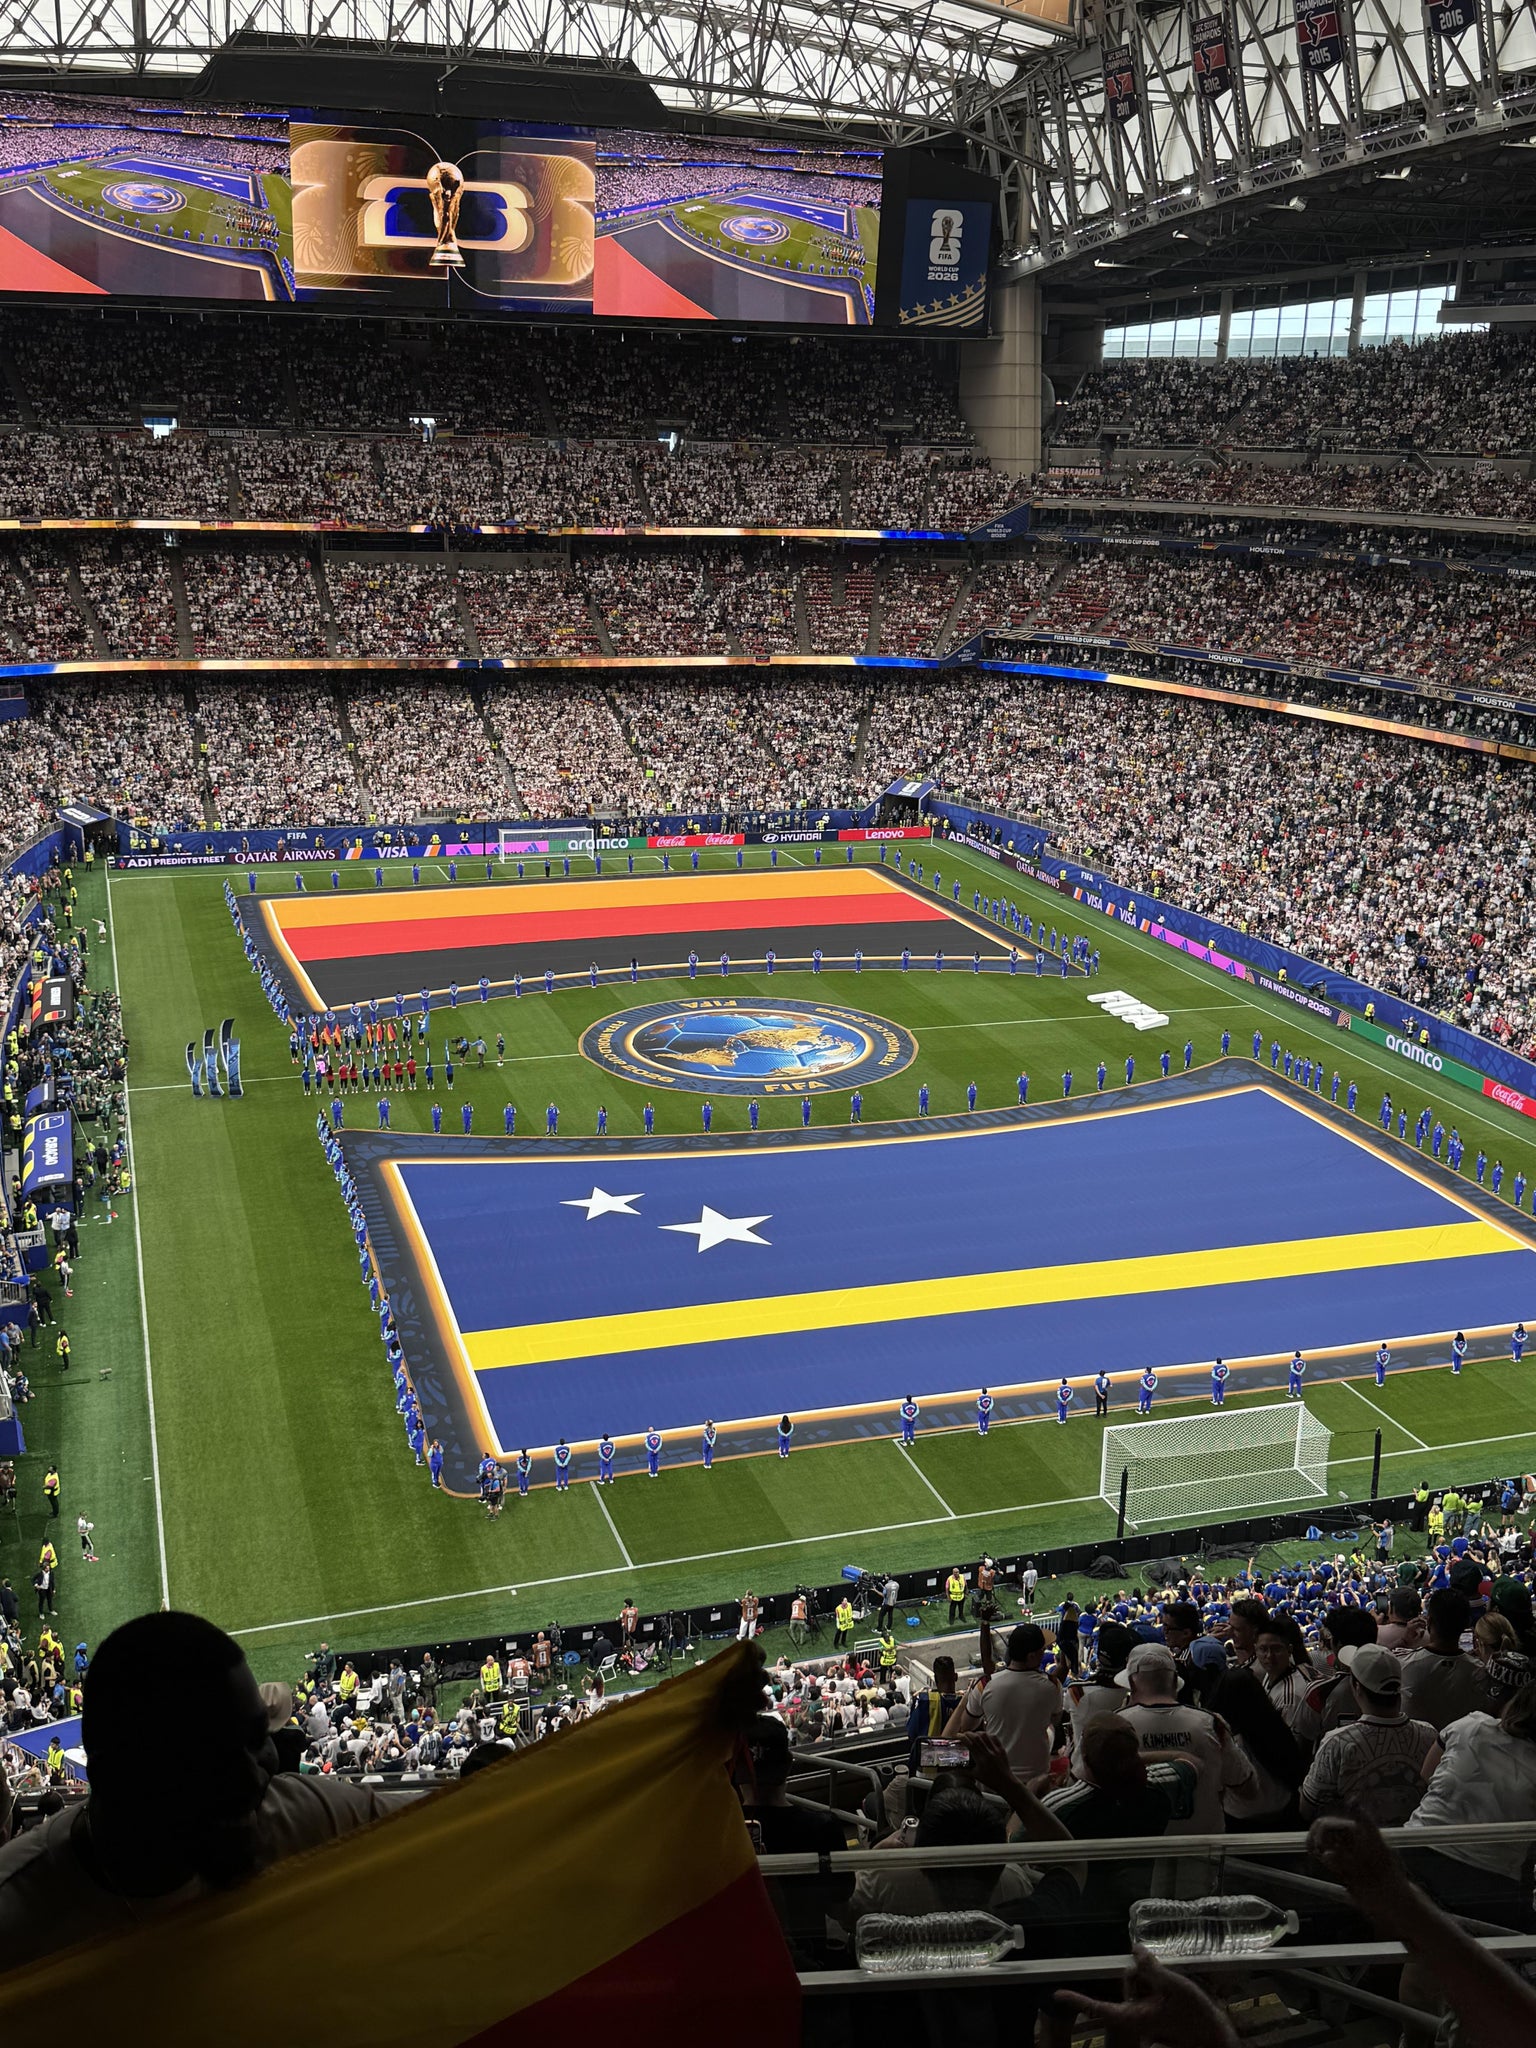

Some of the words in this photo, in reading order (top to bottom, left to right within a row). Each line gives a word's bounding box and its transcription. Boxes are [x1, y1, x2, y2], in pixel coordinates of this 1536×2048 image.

[1296, 0, 1332, 12] CHAMPIO
[1439, 9, 1464, 30] 2016
[1193, 26, 1221, 44] CHAMPIONS
[1309, 47, 1331, 65] 2015
[1203, 76, 1221, 93] 2012
[1117, 101, 1130, 117] 2011
[927, 272, 959, 281] 2026
[1249, 547, 1285, 555] HOUSTON
[1507, 567, 1519, 575] FIFA
[1208, 653, 1243, 664] HOUSTON
[1472, 695, 1516, 709] HOUSTON
[287, 832, 307, 840] FIFA
[780, 831, 822, 843] HYUNDAI
[865, 828, 905, 840] Lenovo
[568, 838, 629, 850] aramco
[948, 831, 965, 844] ADI
[966, 837, 1001, 860] PREDICTSTREET
[234, 852, 278, 864] QATAR
[283, 849, 336, 861] AIRWAYS
[376, 846, 409, 859] VISA
[127, 858, 151, 868] ADI
[154, 855, 226, 866] PREDICTSTREET
[1016, 860, 1035, 878] QATAR
[1036, 870, 1060, 889] AIRWAYS
[1081, 871, 1094, 882] FIFA
[1086, 892, 1103, 911] VISA
[1119, 907, 1137, 927] VISA
[1260, 976, 1273, 990] FIFA
[1273, 984, 1295, 1000] WORLD
[1295, 993, 1308, 1005] CUP
[1308, 1000, 1331, 1016] 2026
[680, 1000, 737, 1009] FIFA
[815, 1007, 868, 1023] 2026
[602, 1020, 628, 1033] FIFA
[863, 1020, 888, 1033] CUP
[597, 1033, 613, 1054] WORLD
[882, 1031, 900, 1053] WORLD
[603, 1053, 627, 1066] CUP
[878, 1051, 900, 1066] FIFA
[1385, 1034, 1442, 1072] aramco
[620, 1064, 676, 1083] 2026
[764, 1080, 831, 1093] FIFA
[483, 1725, 493, 1737] 17
[1142, 1731, 1192, 1749] KIMMICH
